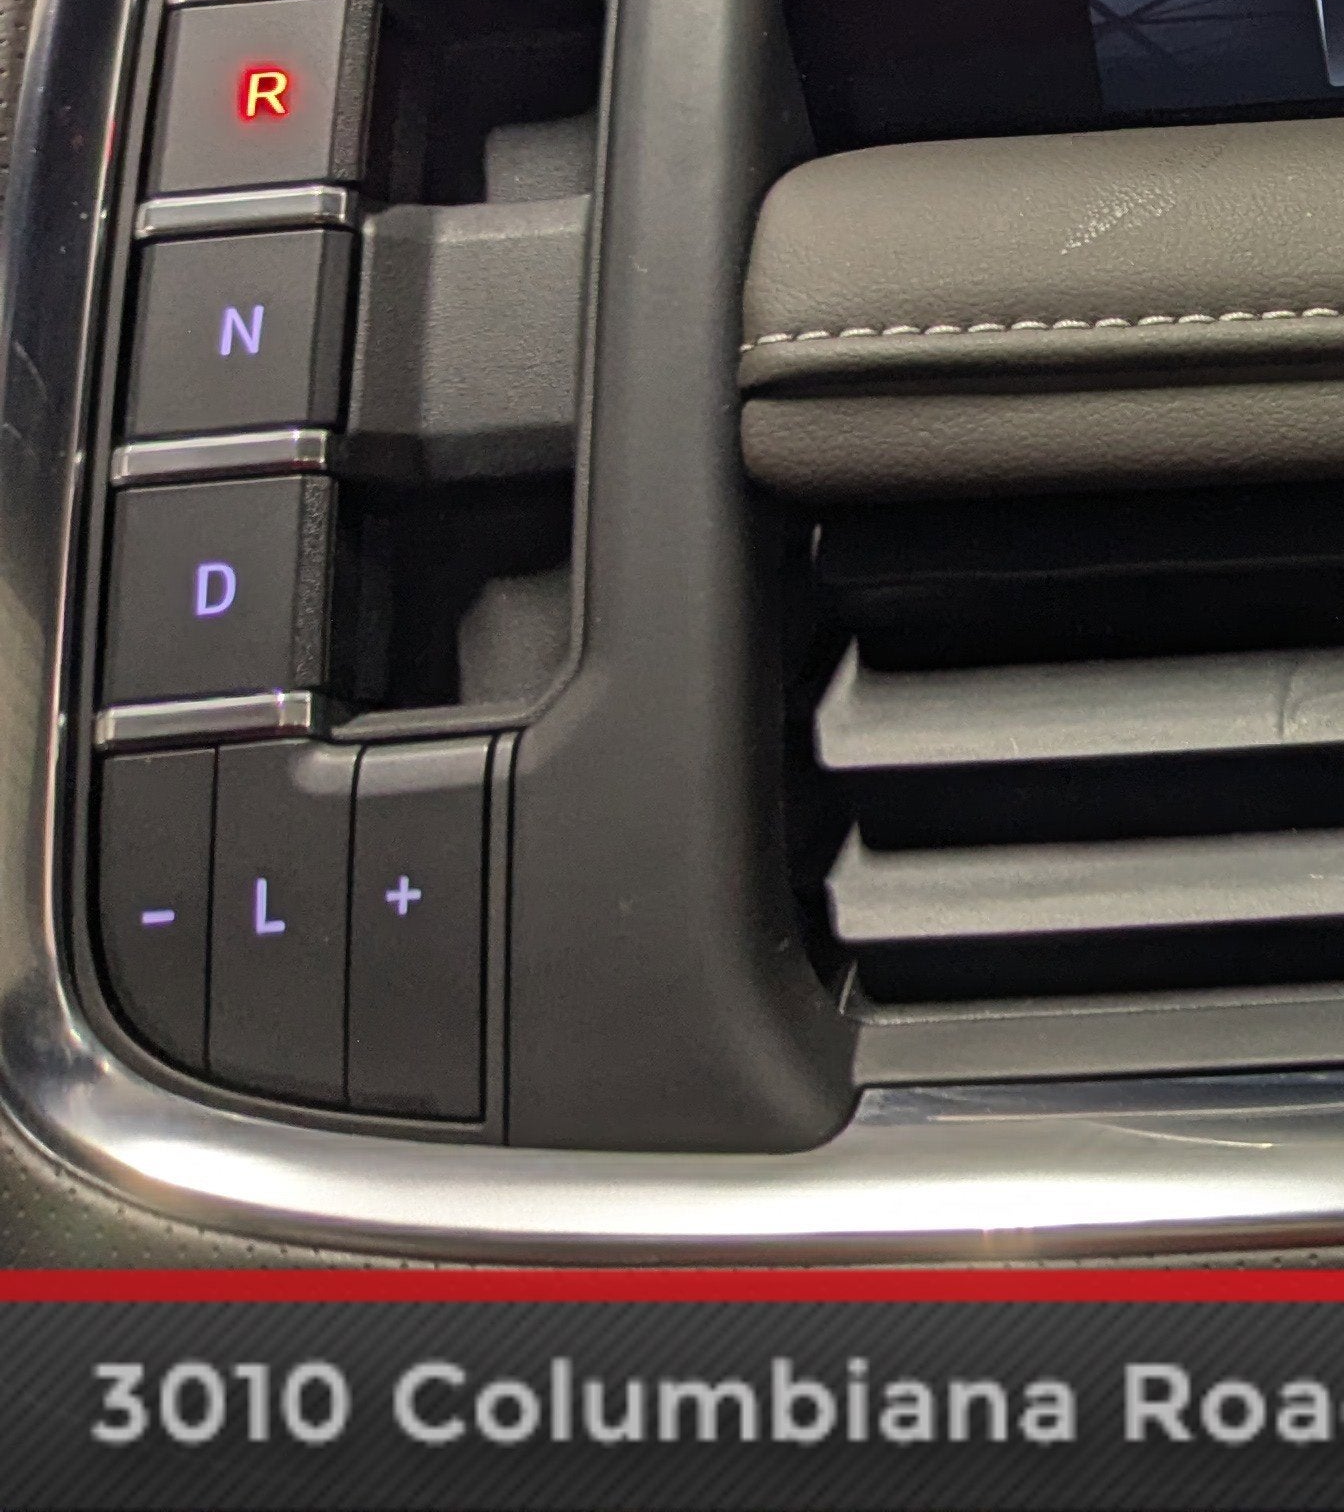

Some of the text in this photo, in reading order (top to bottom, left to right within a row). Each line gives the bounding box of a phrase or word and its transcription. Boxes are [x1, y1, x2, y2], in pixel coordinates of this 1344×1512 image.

[244, 71, 288, 117] R
[219, 305, 265, 355] N
[195, 561, 237, 616] D
[254, 877, 286, 934] L
